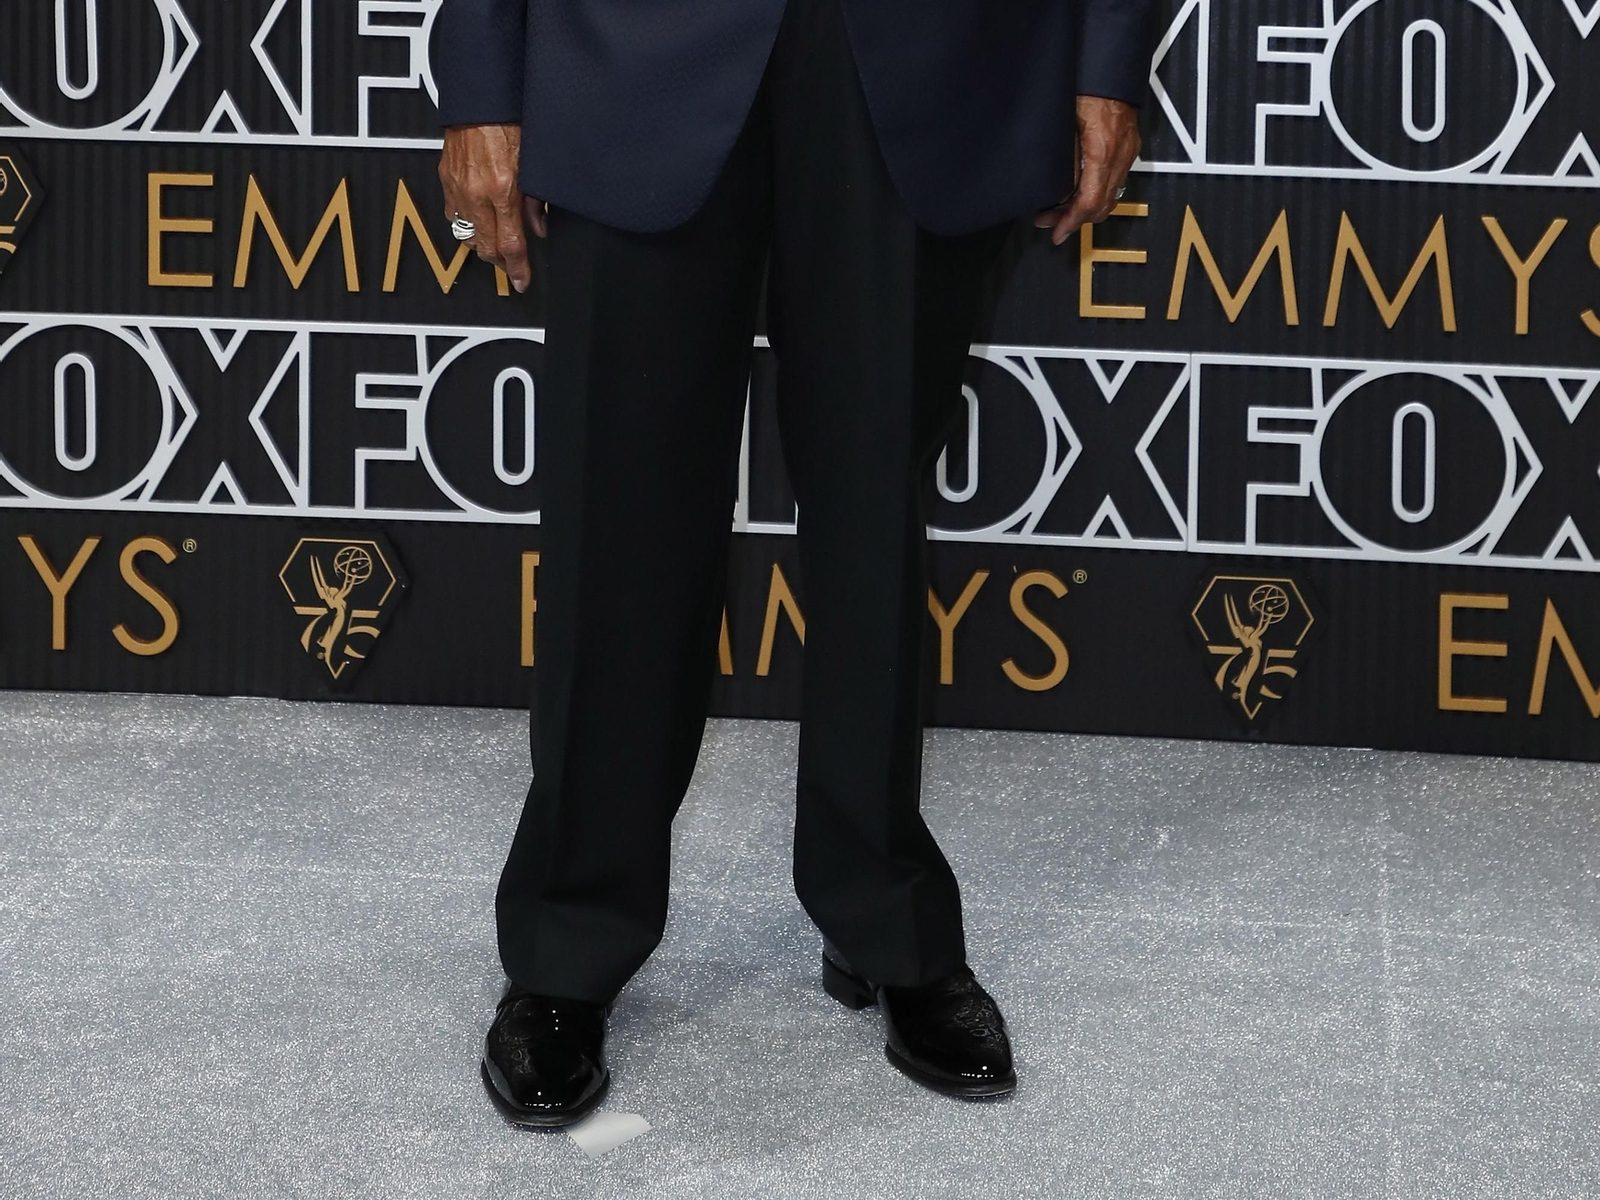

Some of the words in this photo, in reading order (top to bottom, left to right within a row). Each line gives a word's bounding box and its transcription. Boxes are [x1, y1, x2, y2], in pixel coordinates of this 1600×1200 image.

[148, 173, 510, 296] EMM
[1079, 203, 1600, 338] EMMY
[0, 312, 310, 515] OX
[300, 322, 546, 525] FO
